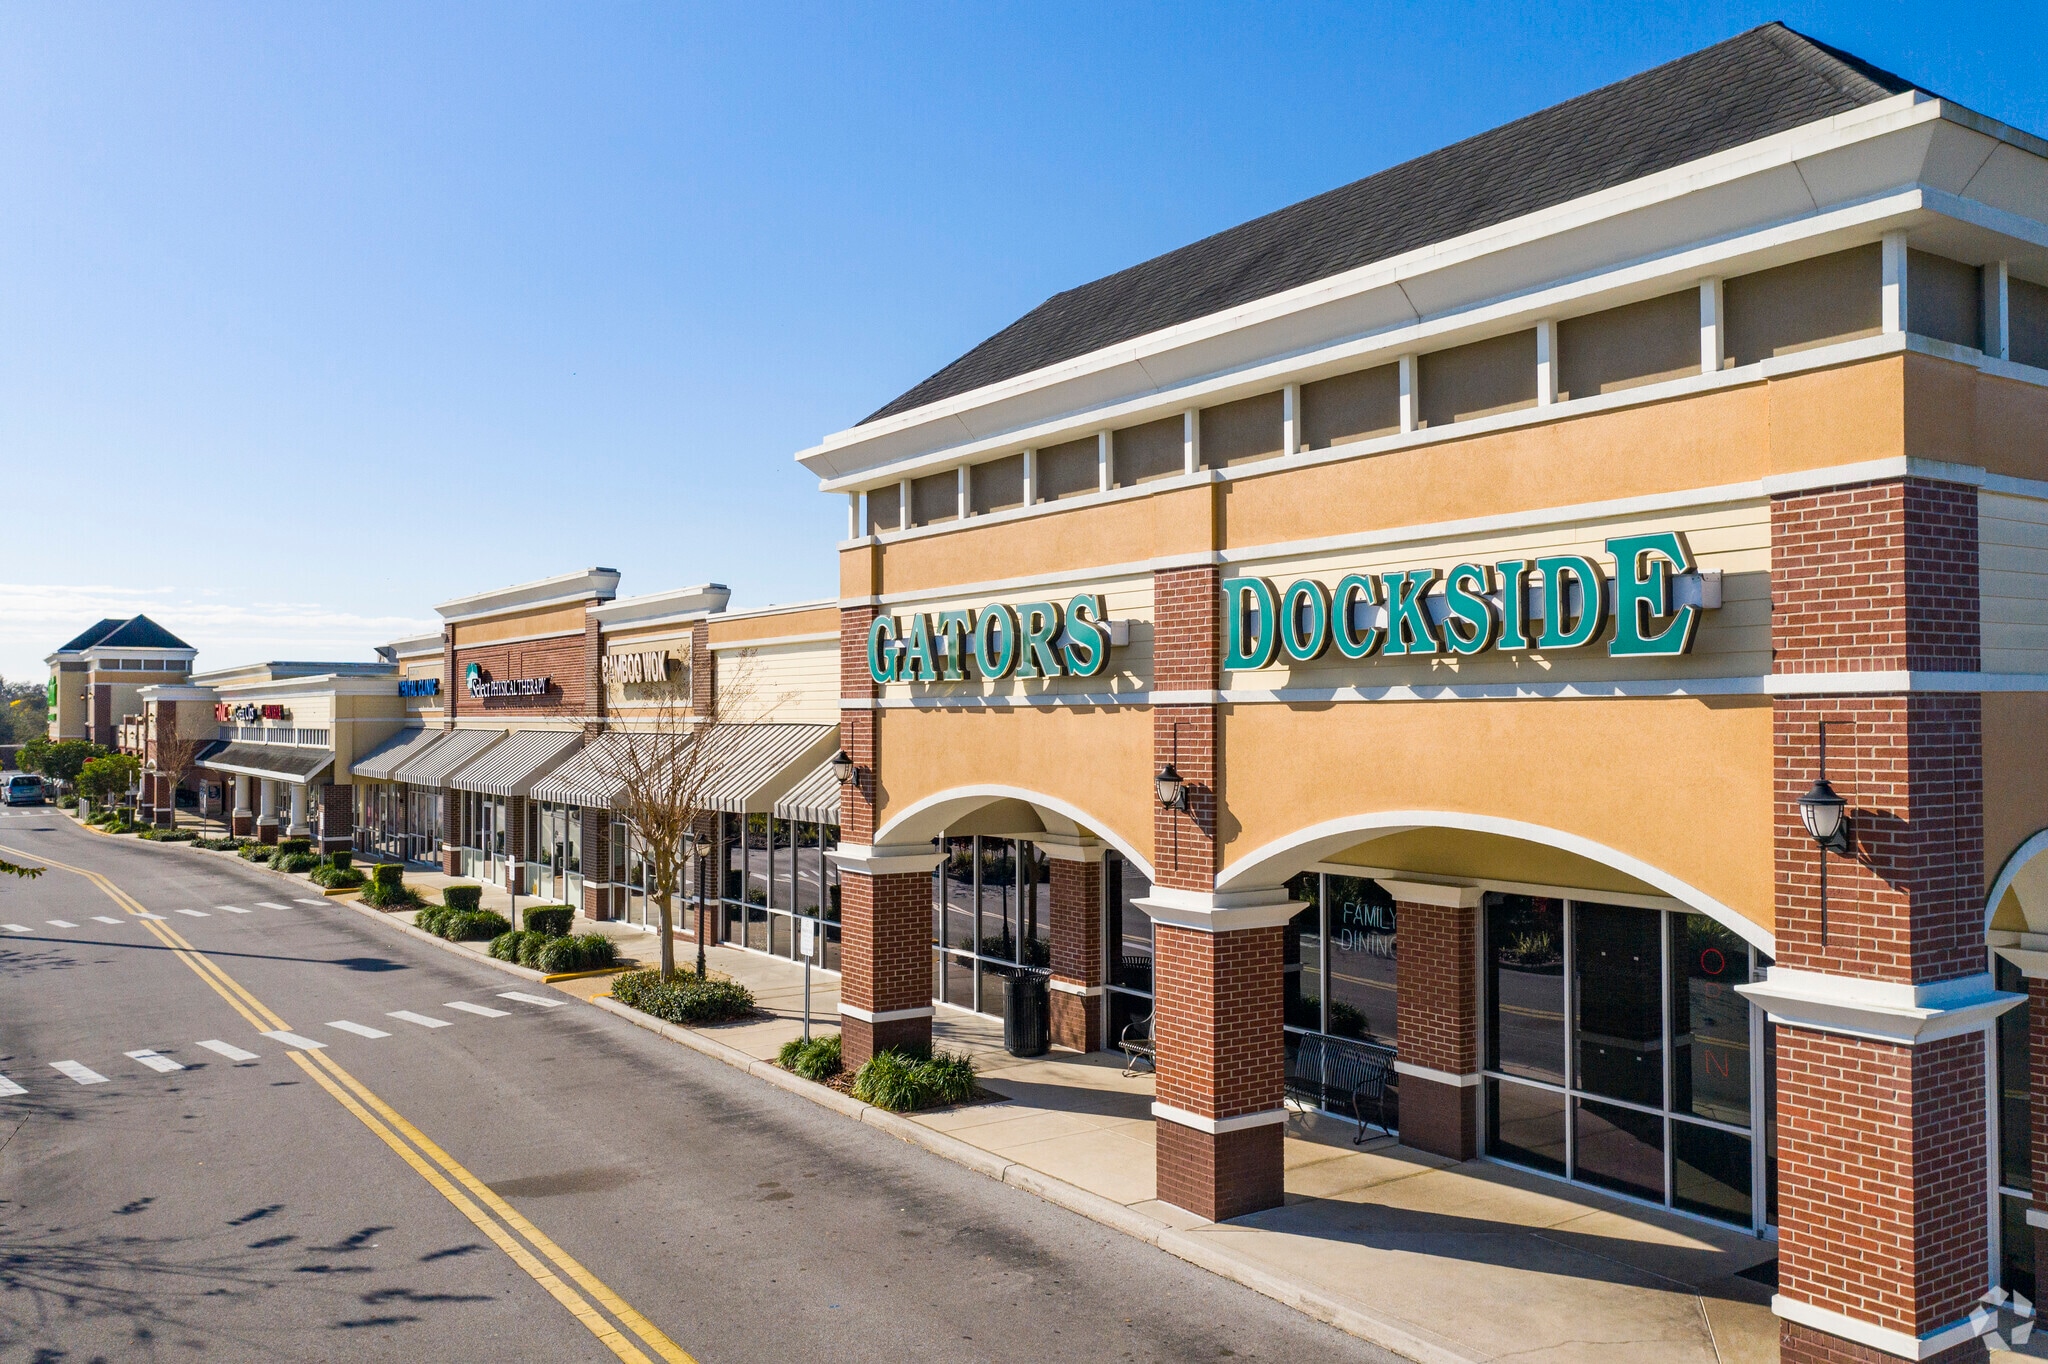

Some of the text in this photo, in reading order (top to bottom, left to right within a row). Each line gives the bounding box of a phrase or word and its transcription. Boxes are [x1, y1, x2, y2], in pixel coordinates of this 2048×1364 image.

[867, 531, 1699, 684] GATORS DOCKSIDE
[602, 650, 668, 684] BAMBOO WOK
[418, 678, 437, 696] CLINIC
[471, 677, 547, 698] Select PHYSICAL THERAPY
[1344, 902, 1397, 930] FAMILY
[1700, 947, 1729, 1078] OPN
